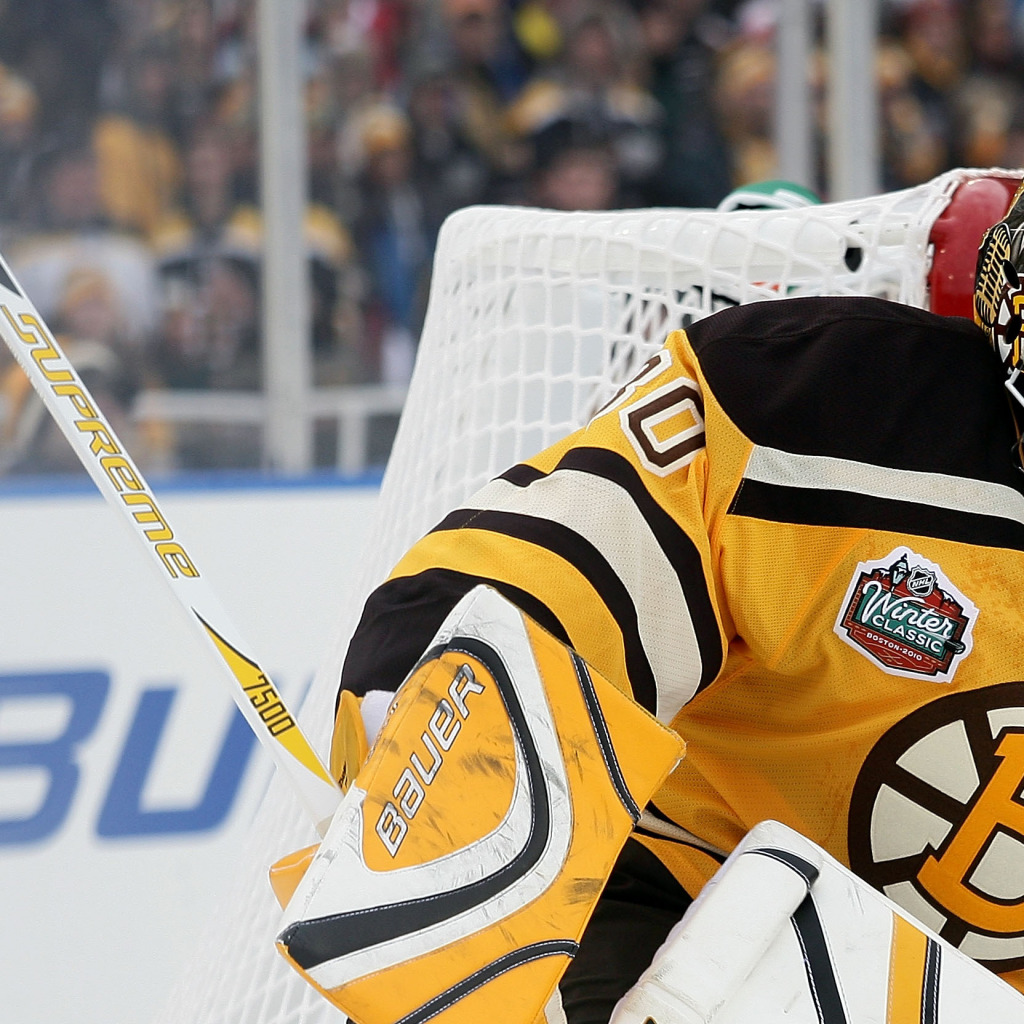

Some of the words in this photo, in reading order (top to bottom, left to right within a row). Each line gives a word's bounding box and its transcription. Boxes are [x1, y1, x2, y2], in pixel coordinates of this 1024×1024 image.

[0, 304, 200, 579] SUPREME
[862, 580, 953, 640] Winter
[911, 578, 931, 588] NHL
[872, 614, 944, 654] CLASSIC
[242, 672, 297, 738] 7500
[374, 662, 486, 859] BAUER
